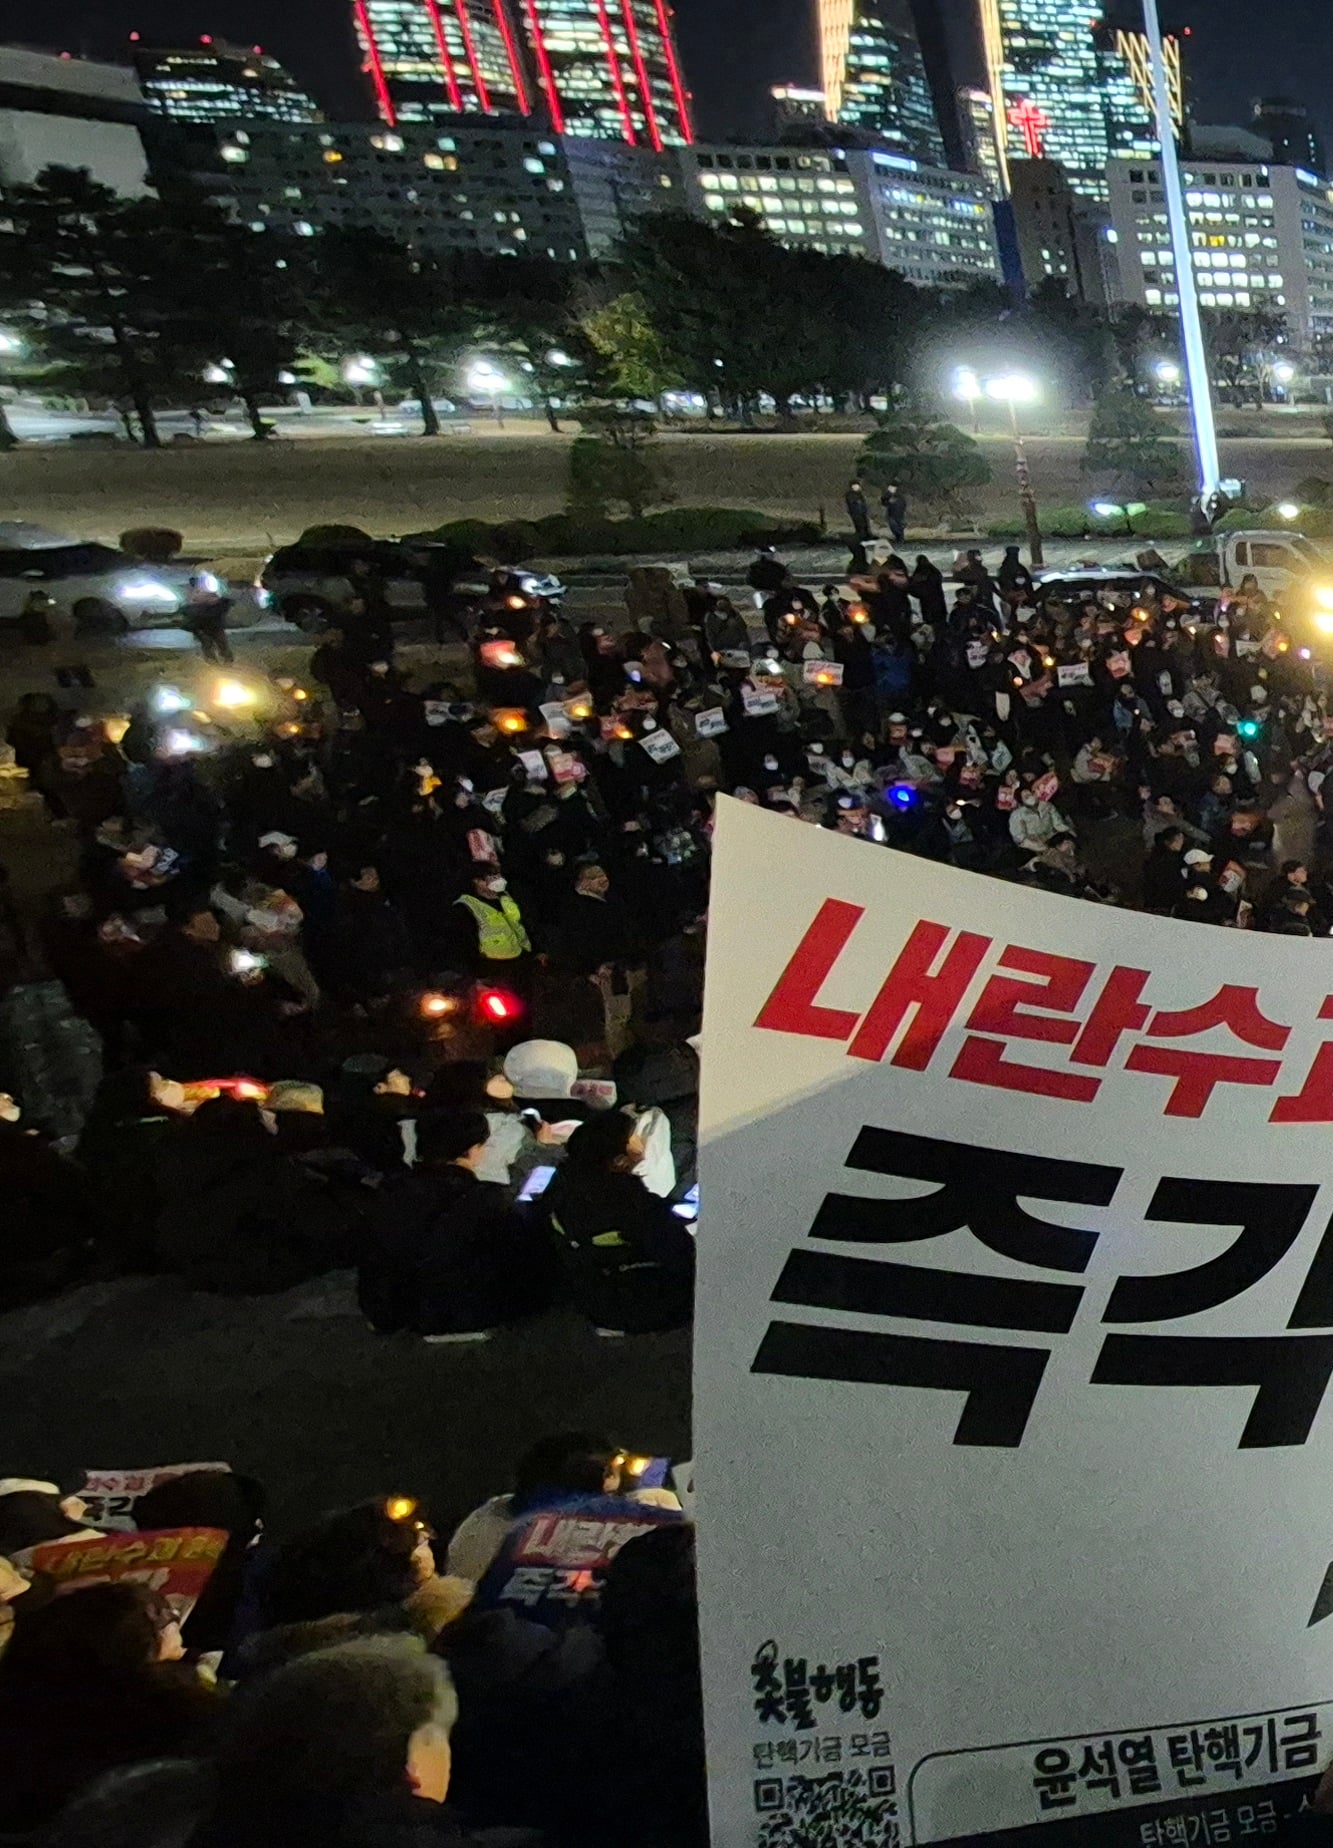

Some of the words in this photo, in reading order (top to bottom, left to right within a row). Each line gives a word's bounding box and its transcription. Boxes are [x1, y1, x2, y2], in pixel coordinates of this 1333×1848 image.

[751, 1640, 884, 1732] 촛불행동
[752, 1736, 842, 1770] 탄핵기금
[850, 1731, 892, 1758] 모금
[1032, 1735, 1162, 1811] 윤석열
[1168, 1712, 1322, 1783] 탄핵기금
[1140, 1808, 1231, 1848] 탄핵기금
[1238, 1802, 1278, 1836] 모금
